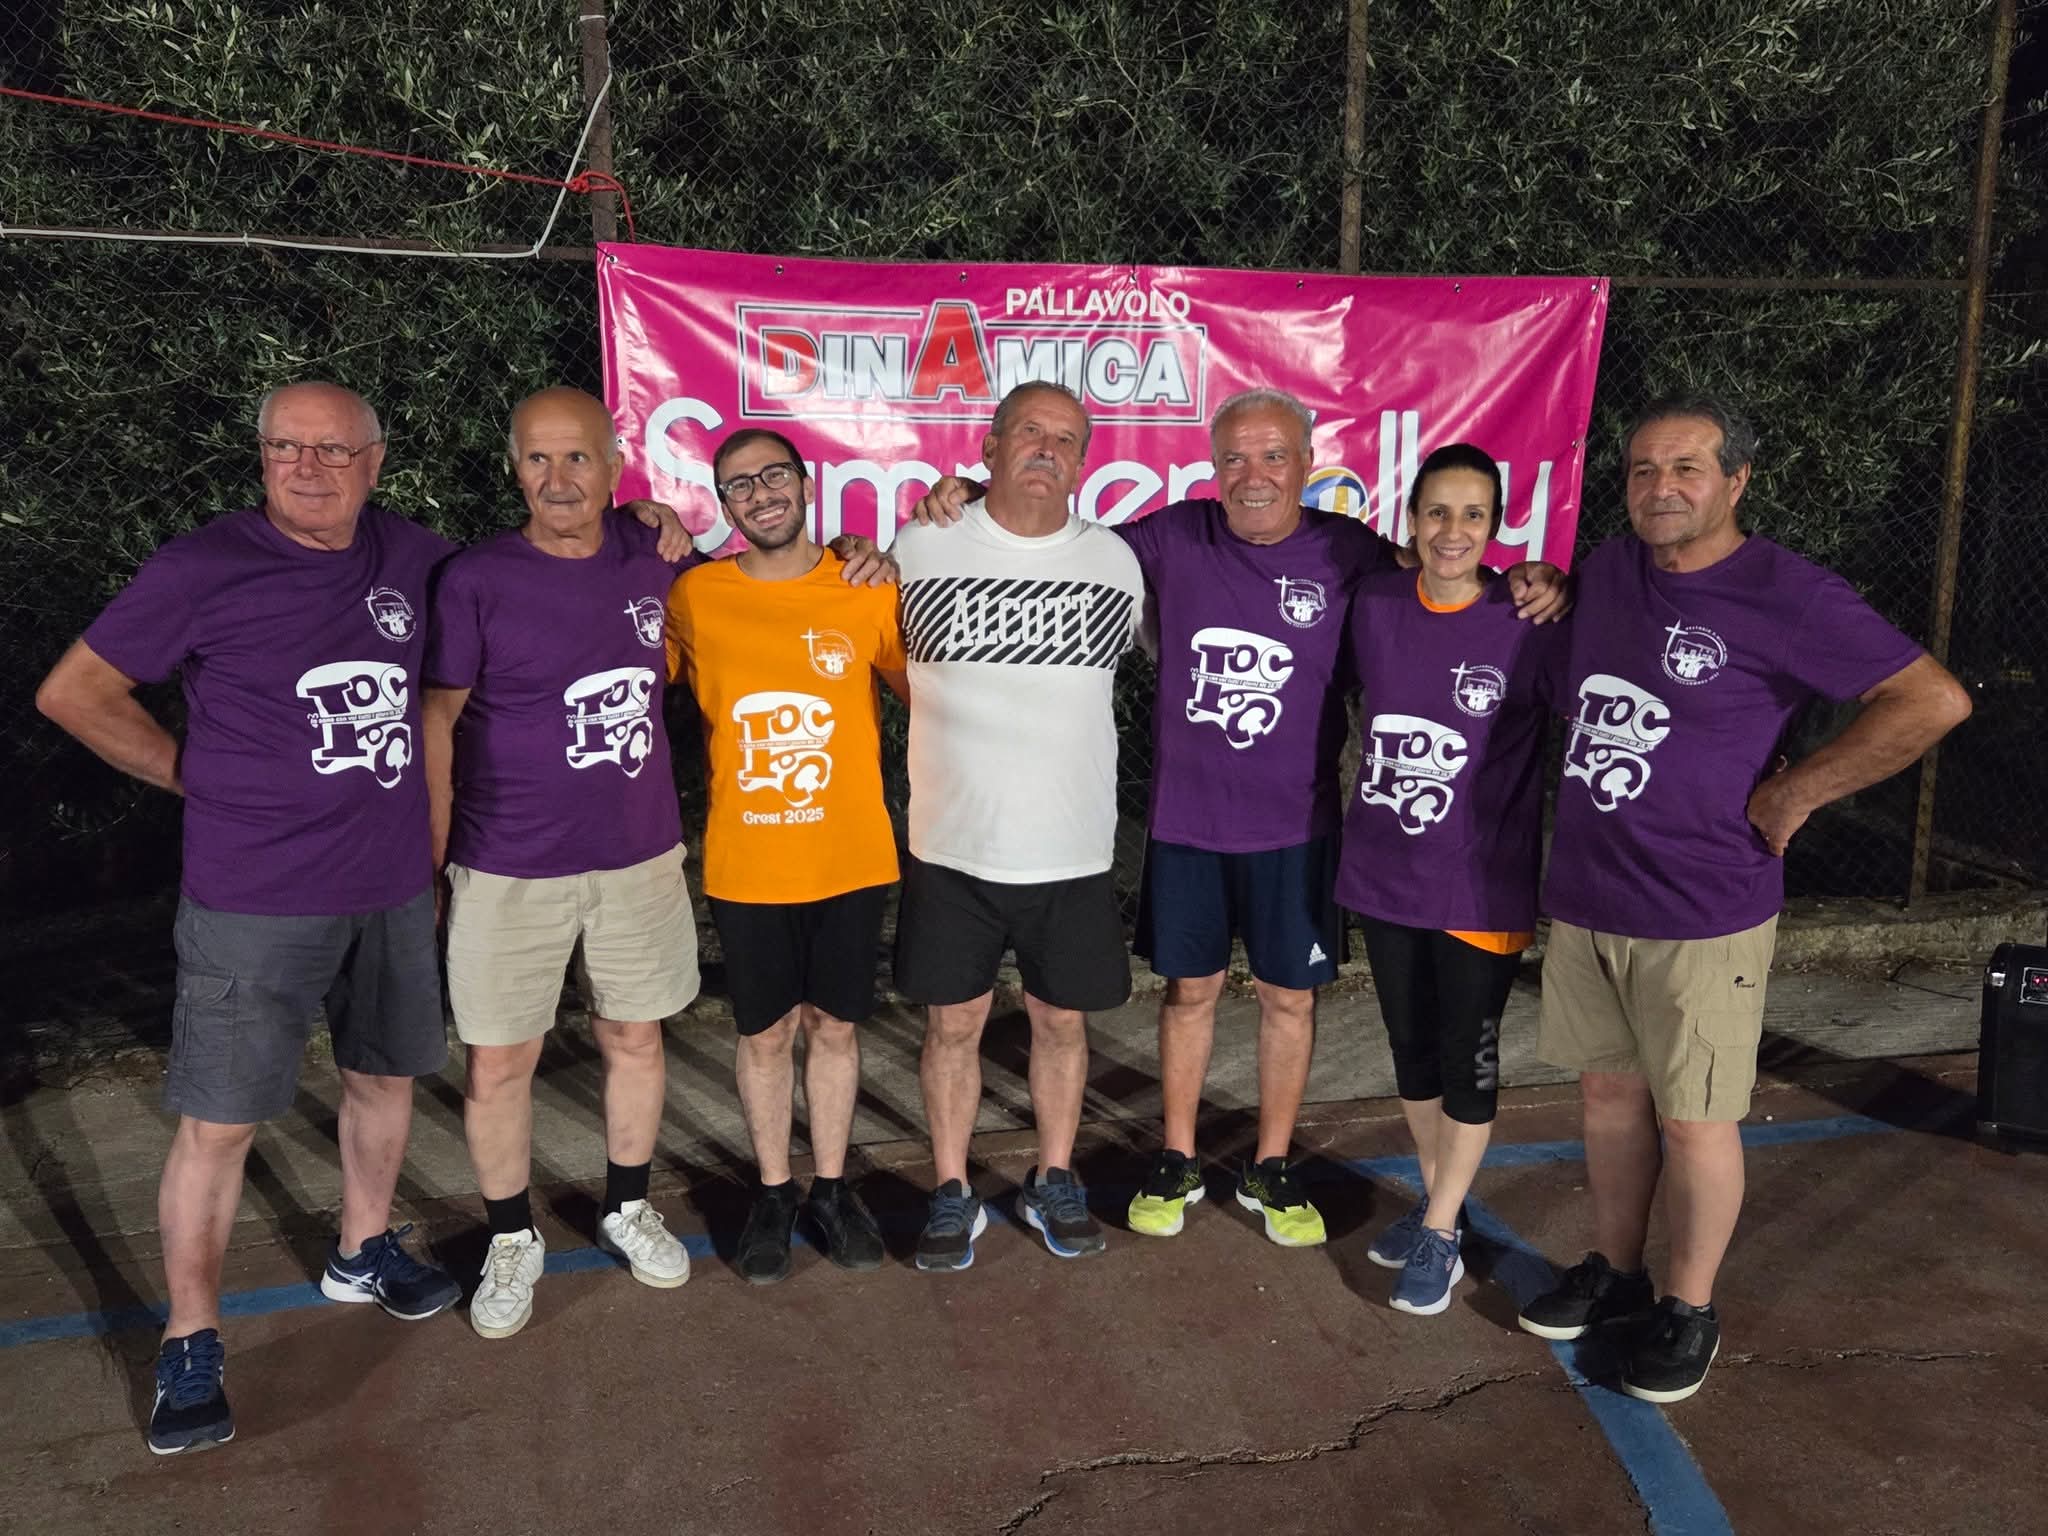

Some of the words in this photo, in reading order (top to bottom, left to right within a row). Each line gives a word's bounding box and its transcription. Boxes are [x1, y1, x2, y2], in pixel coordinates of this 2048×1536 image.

[1007, 288, 1191, 318] PALLAVOLO
[761, 301, 1191, 405] DINAMICA
[946, 589, 1094, 655] ALCOTT
[742, 810, 781, 824] Grest
[784, 807, 825, 824] 2025
